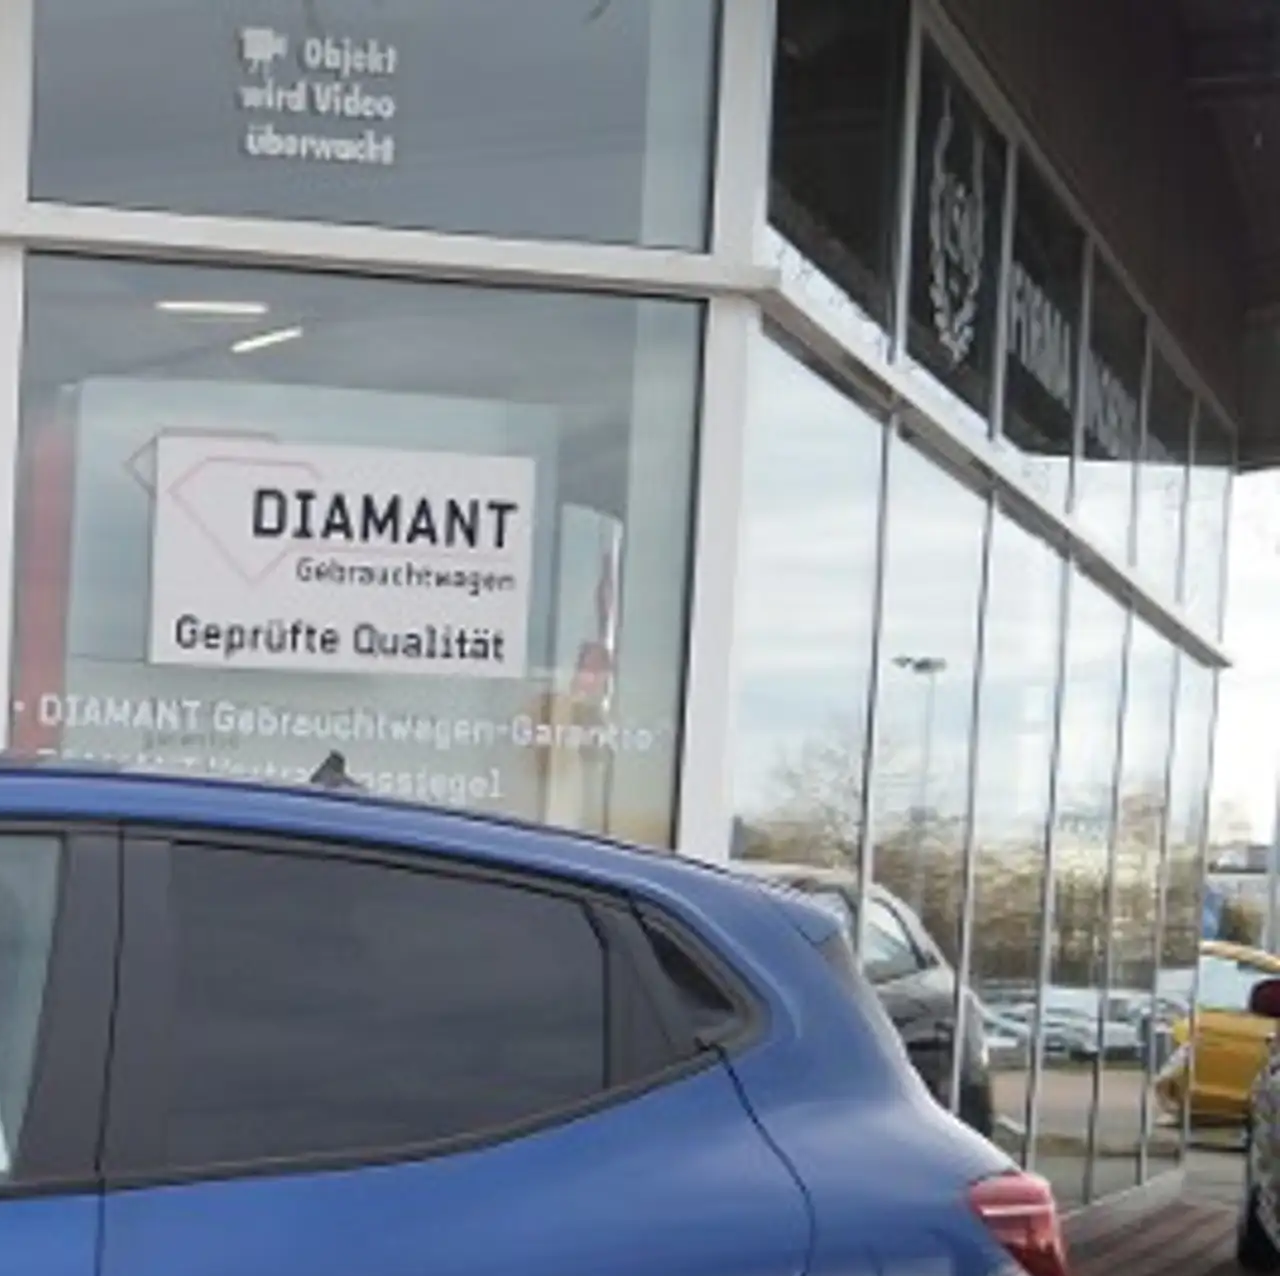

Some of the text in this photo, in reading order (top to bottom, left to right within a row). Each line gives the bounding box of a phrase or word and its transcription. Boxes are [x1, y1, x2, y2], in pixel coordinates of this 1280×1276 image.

[303, 37, 397, 76] Objekt
[240, 78, 396, 118] wird Video
[245, 123, 395, 165] überwacht
[252, 488, 519, 550] DIAMANT
[295, 556, 515, 597] Gebrauchtwagen
[174, 613, 505, 662] Geprüfte Qualität
[38, 692, 200, 730] DIAMANT
